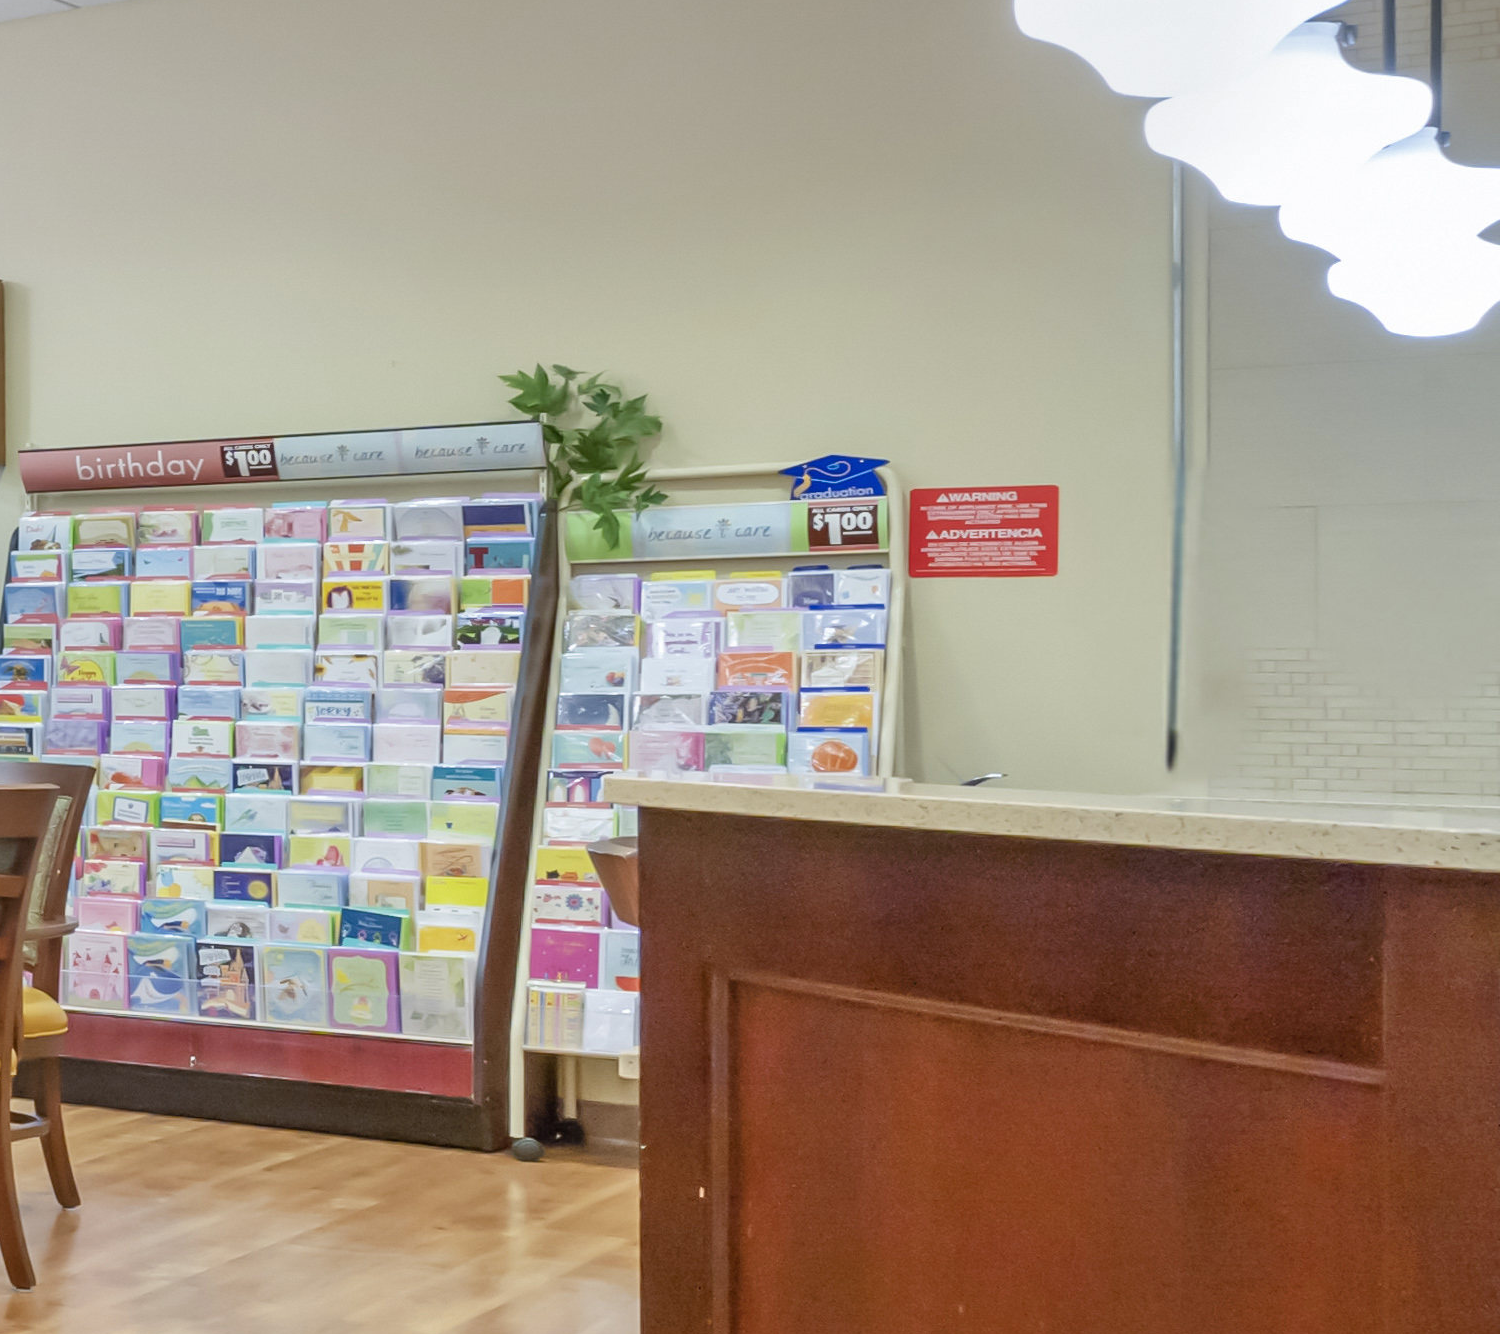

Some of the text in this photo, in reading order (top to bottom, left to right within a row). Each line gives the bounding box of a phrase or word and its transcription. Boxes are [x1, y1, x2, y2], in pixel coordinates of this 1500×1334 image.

[280, 453, 334, 466] because
[353, 449, 385, 462] care
[414, 445, 474, 459] because
[493, 442, 528, 455] care
[75, 450, 205, 481] birthday
[799, 486, 875, 501] graduation
[948, 490, 1018, 502] WARNING
[648, 525, 712, 541] because
[734, 524, 771, 538] care
[939, 527, 1043, 540] ADVERTENCIA
